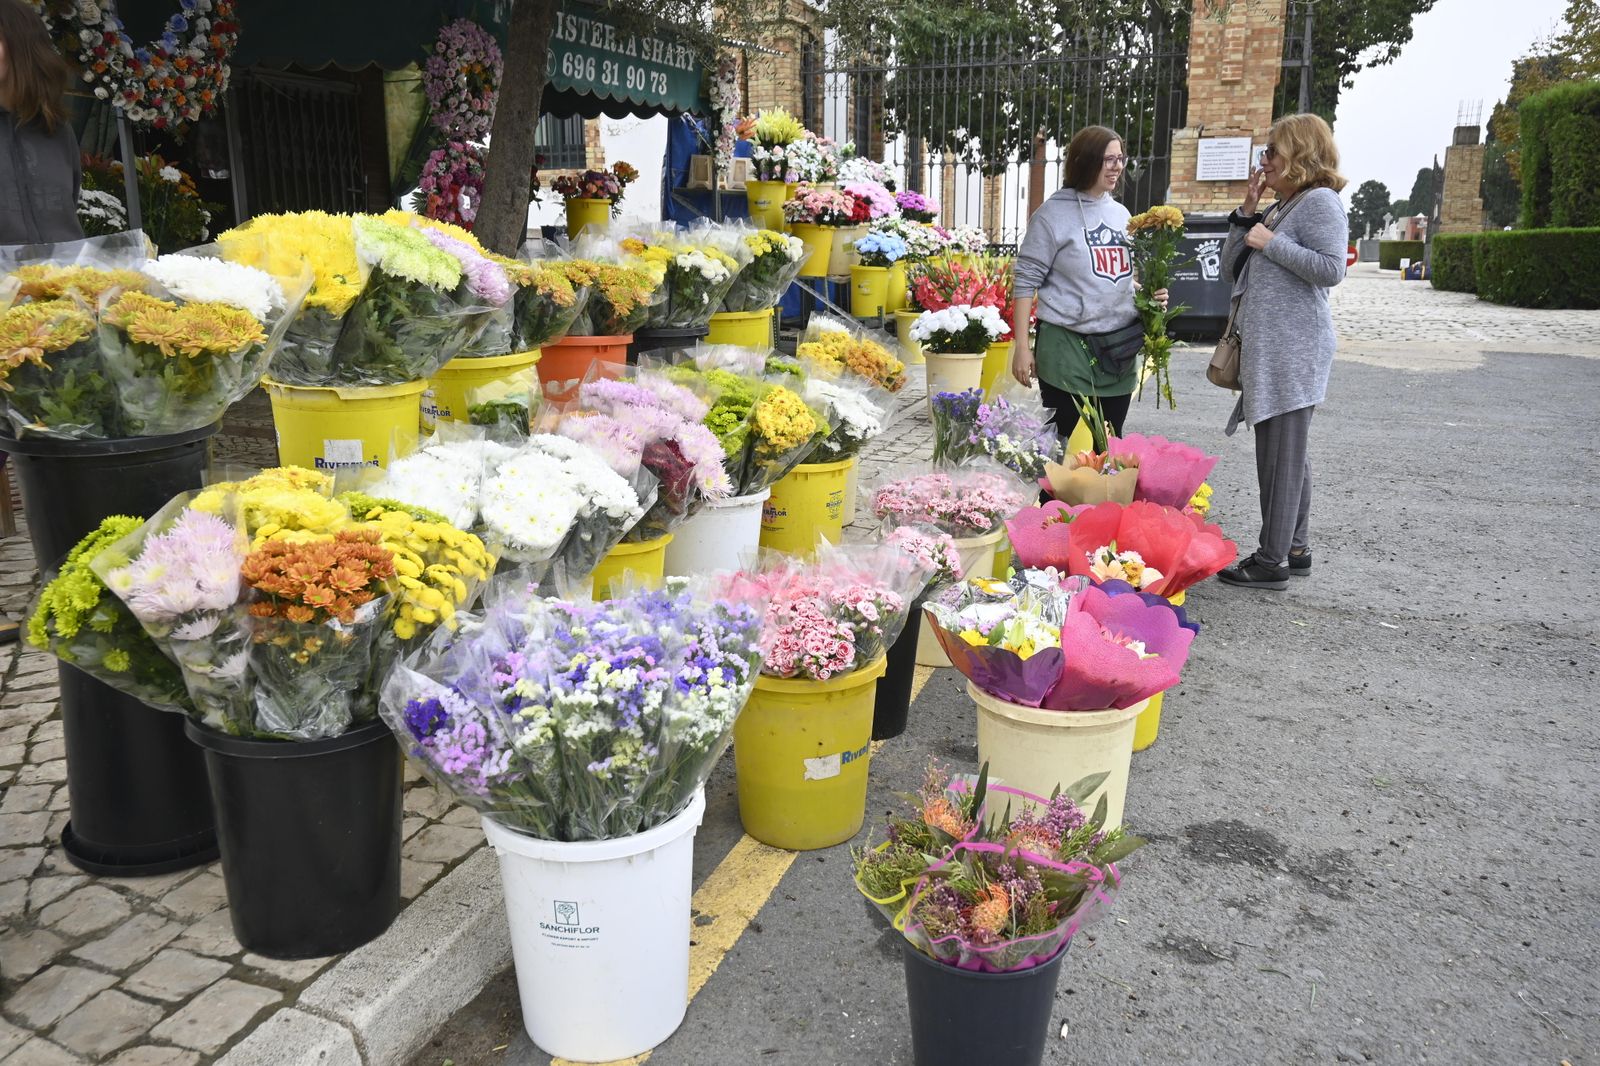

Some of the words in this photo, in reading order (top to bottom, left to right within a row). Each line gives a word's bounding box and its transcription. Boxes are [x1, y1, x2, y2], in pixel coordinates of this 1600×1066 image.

[641, 36, 696, 72] SHARY
[562, 52, 596, 82] 696
[601, 60, 620, 86] 31
[626, 65, 646, 91] 90
[650, 70, 668, 95] 73
[1094, 248, 1129, 276] NFL
[539, 922, 600, 934] SANCHIFLOR
